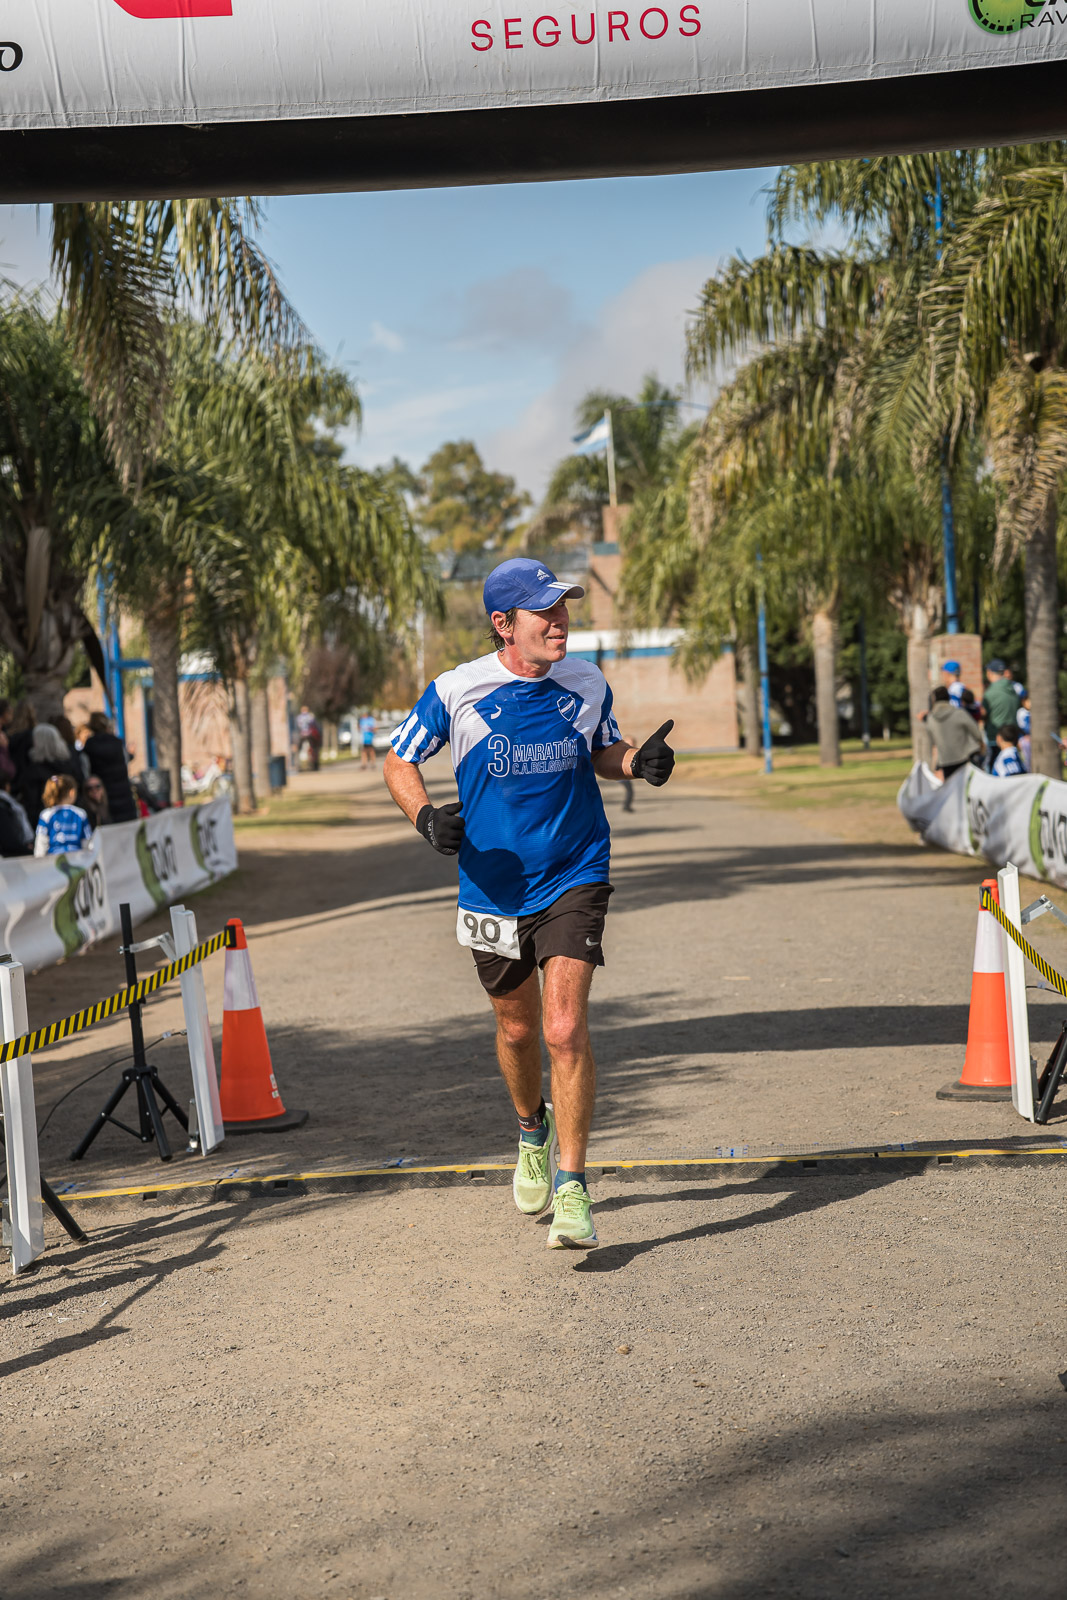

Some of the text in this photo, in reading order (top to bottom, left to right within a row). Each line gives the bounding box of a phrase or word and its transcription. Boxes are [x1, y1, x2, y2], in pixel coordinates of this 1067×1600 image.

[470, 4, 703, 52] SEGUROS
[488, 734, 511, 778] 3
[512, 736, 578, 762] MARATÓN
[463, 912, 501, 944] 90
